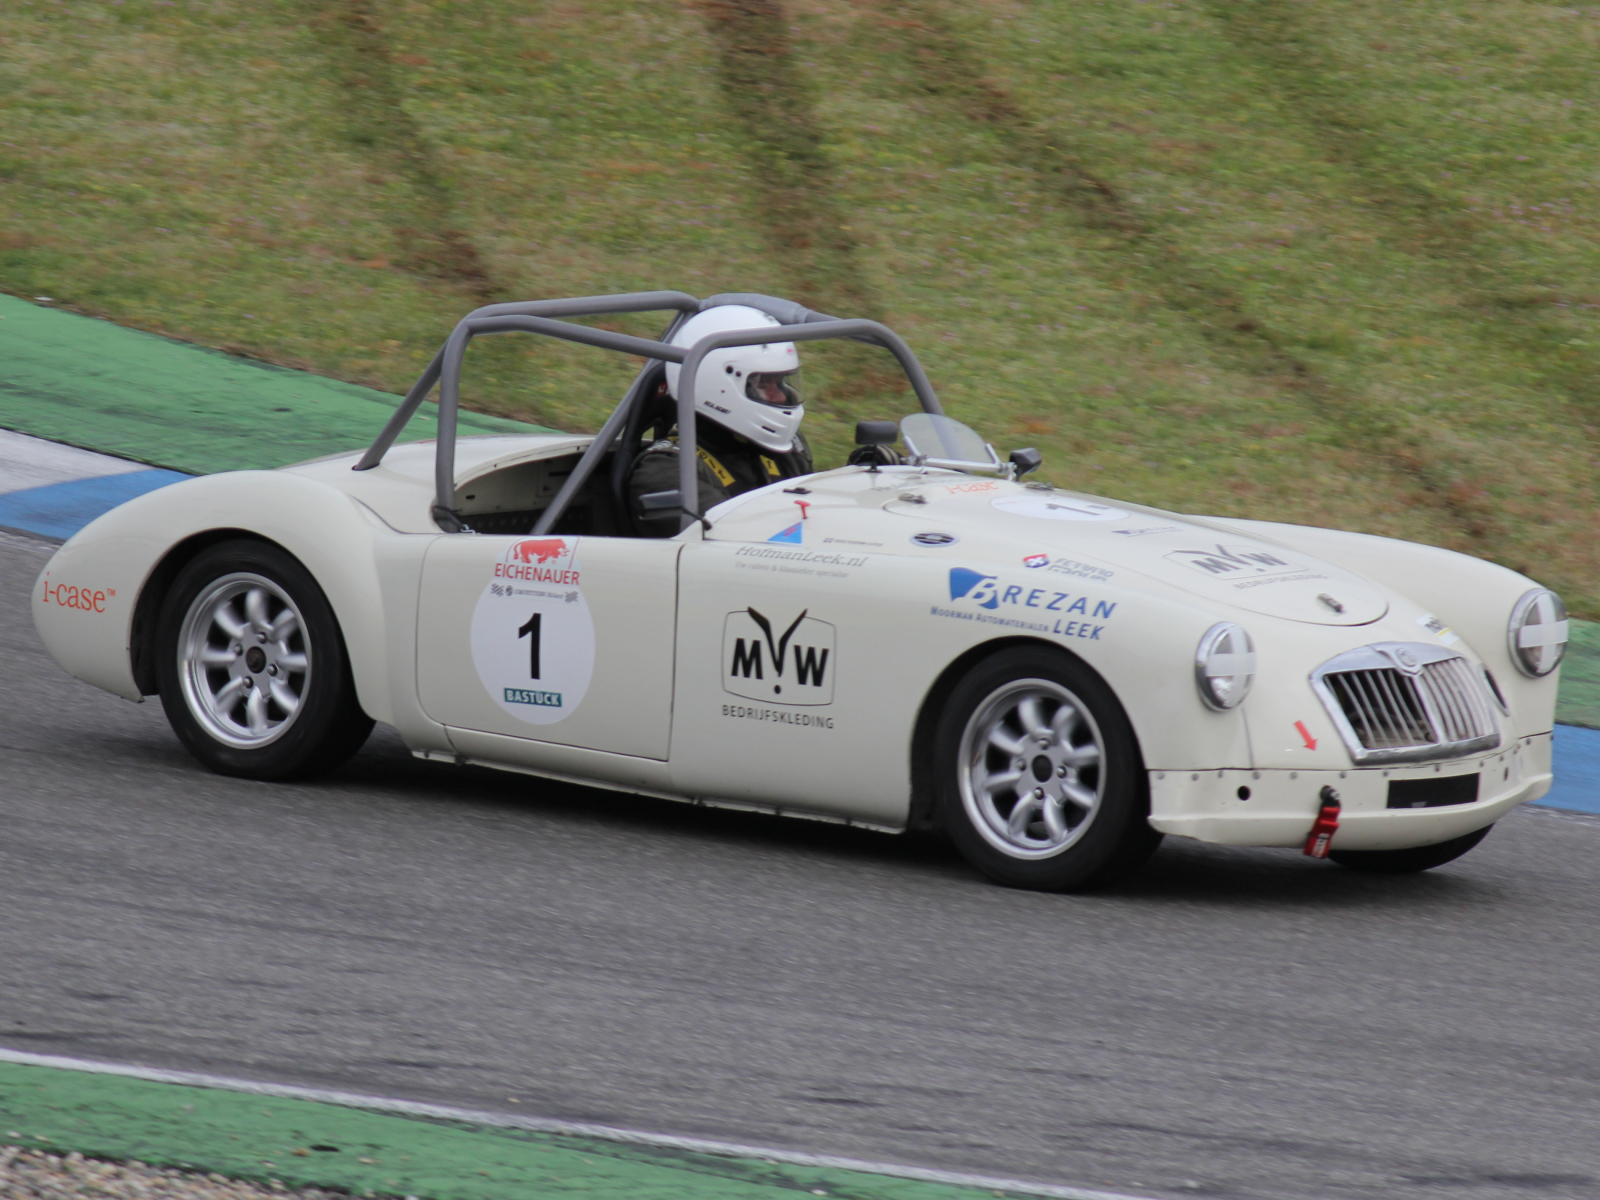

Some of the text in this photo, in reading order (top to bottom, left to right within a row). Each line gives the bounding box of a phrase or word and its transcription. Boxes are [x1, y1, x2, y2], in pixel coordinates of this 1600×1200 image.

[735, 545, 869, 567] HofmanLeek.nl
[494, 563, 580, 586] EICHENAUER
[966, 575, 1117, 619] BREZAN
[1053, 619, 1106, 640] LEEK
[518, 612, 541, 680] 1
[505, 688, 560, 706] BASTUCK
[722, 704, 834, 729] BEDRIJFSKLEDING
